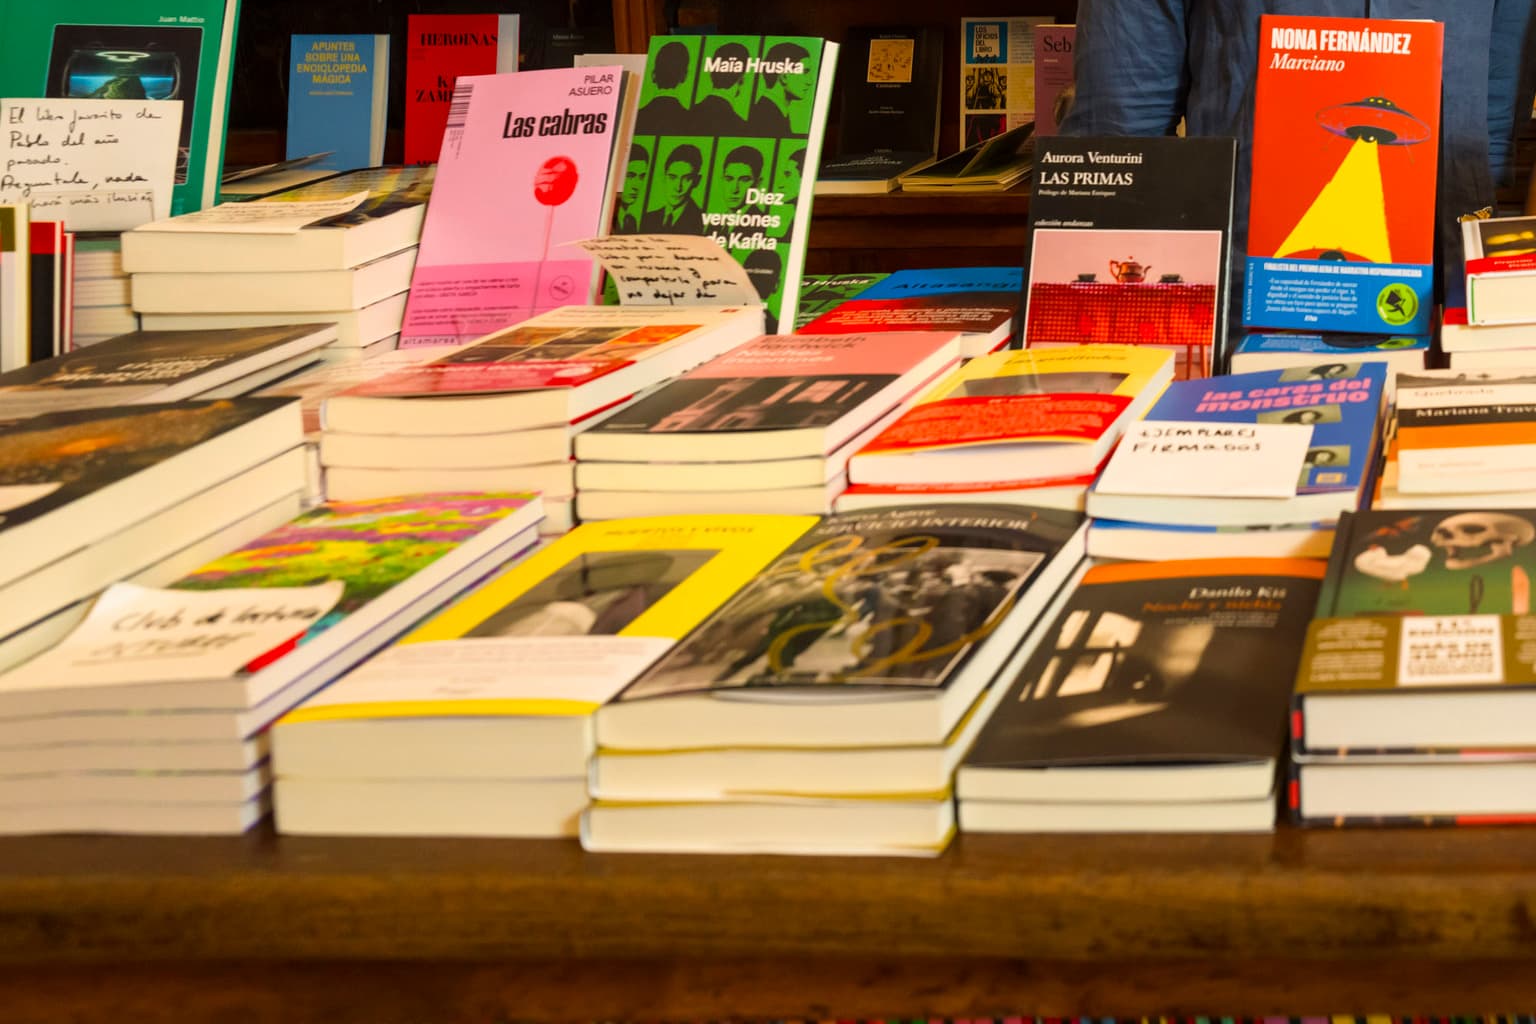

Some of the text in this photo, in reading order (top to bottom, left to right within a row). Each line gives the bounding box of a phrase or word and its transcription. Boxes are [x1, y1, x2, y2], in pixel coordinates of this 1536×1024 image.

[1270, 27, 1412, 55] NONA FERNÁNDEZ
[703, 56, 804, 75] Maïa Hruska
[1269, 52, 1345, 72] Marciano
[584, 73, 614, 84] PILAR
[568, 85, 613, 97] ASUERO
[9, 106, 25, 124] El
[502, 107, 608, 139] Las cabras
[1041, 151, 1144, 165] Aurora Venturini
[1039, 172, 1134, 187] LAS PRIMAS
[745, 188, 785, 206] Diez
[700, 210, 781, 229] versiones
[728, 231, 778, 252] Kafka
[1202, 377, 1372, 402] las caras del
[1195, 392, 1370, 414] monstruo
